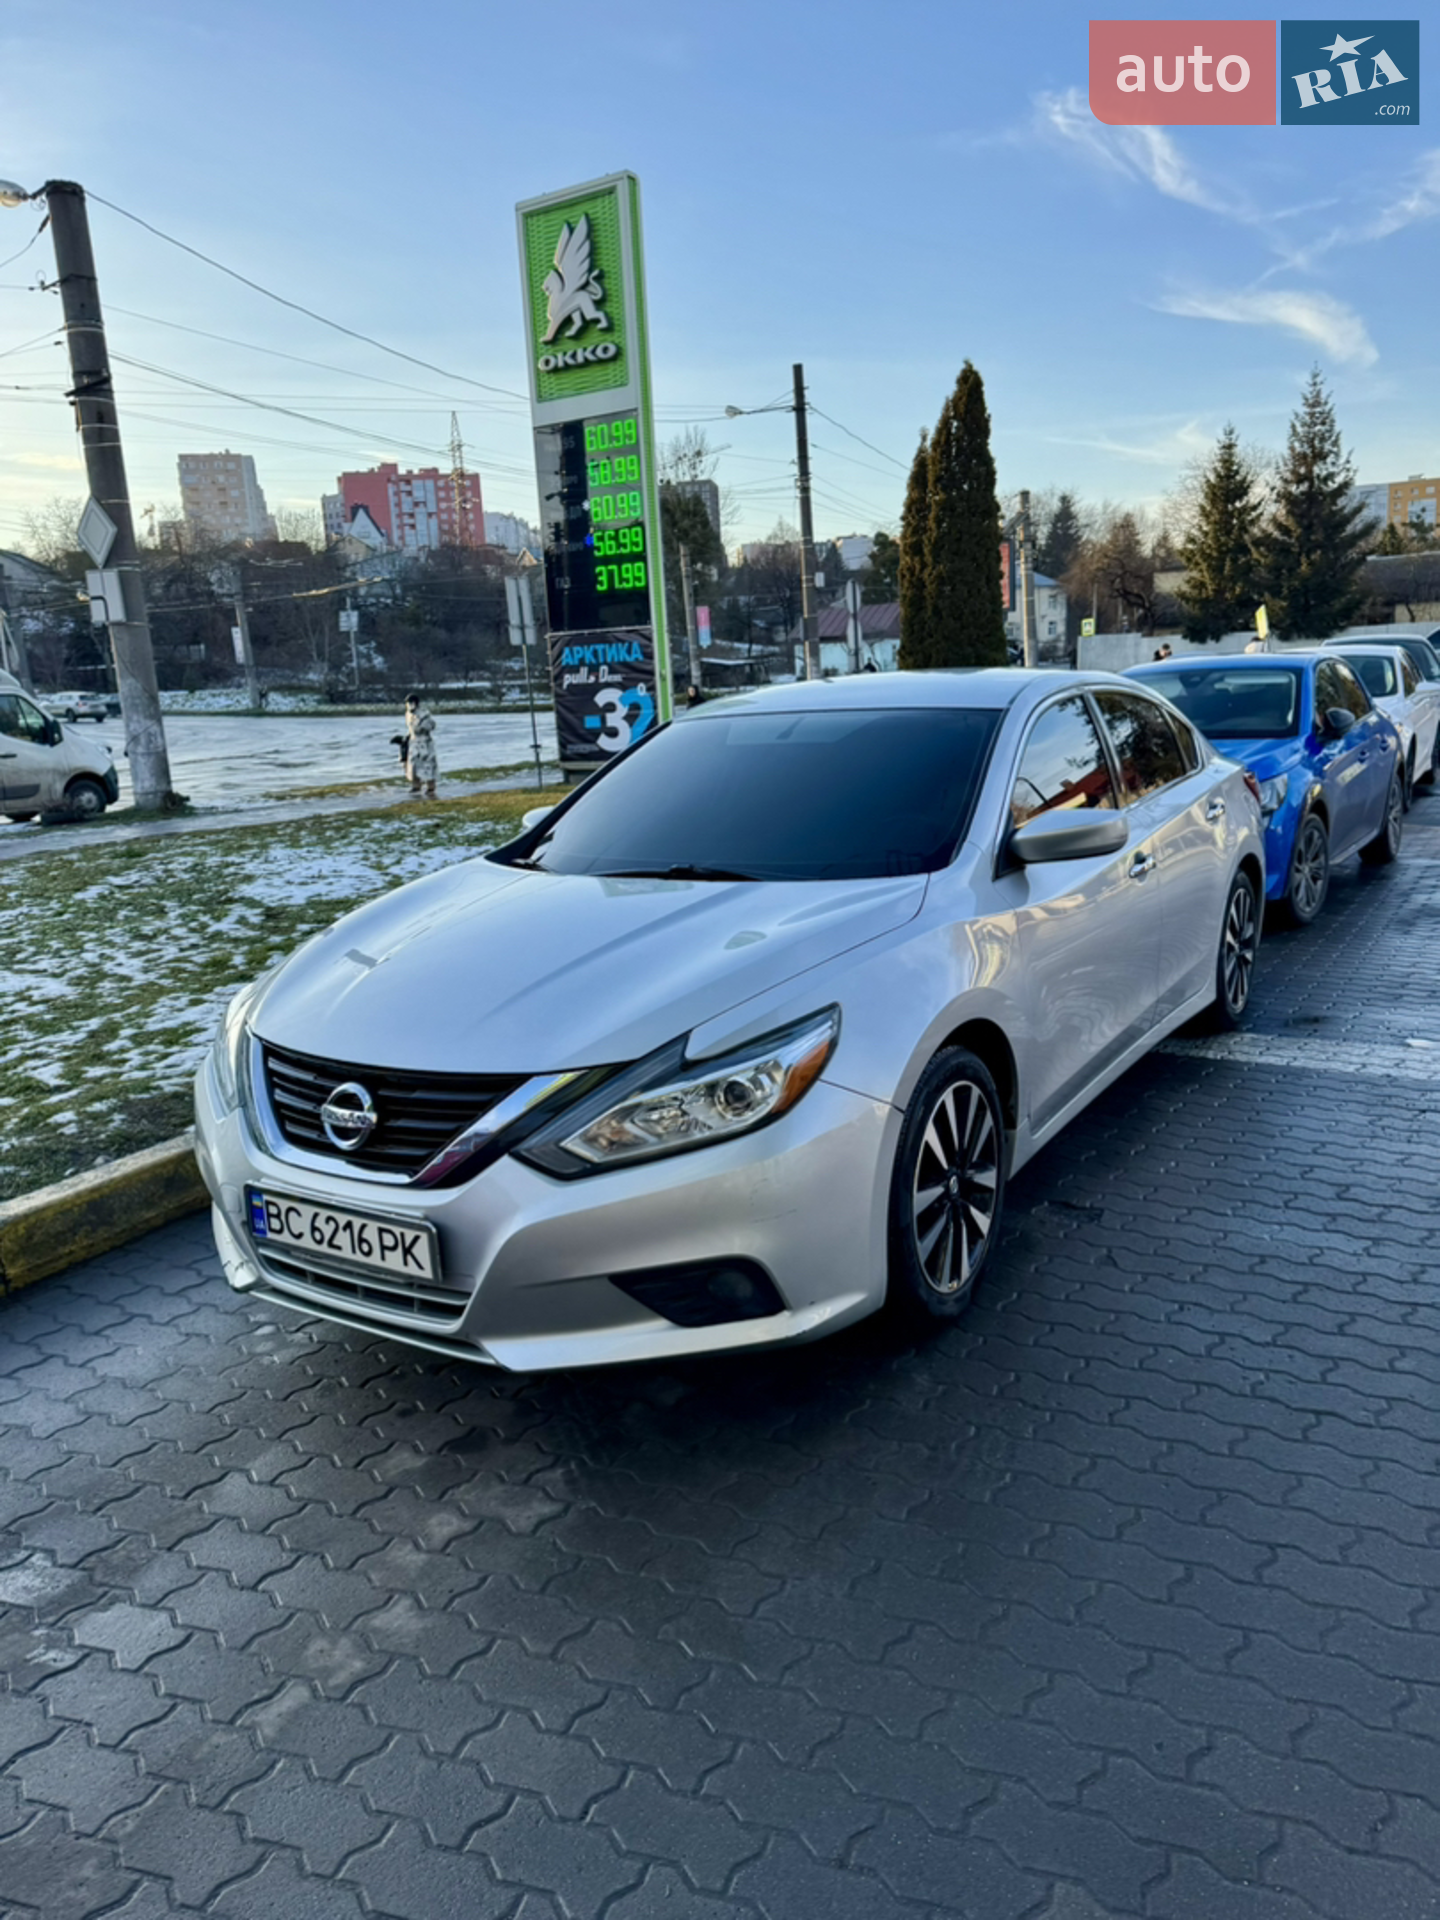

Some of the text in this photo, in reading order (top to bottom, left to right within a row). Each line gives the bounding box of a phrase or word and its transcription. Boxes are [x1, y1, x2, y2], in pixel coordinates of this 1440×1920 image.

[538, 342, 618, 372] OKKO
[585, 418, 637, 452] 60.99
[588, 454, 640, 487] 58.99
[590, 491, 641, 523] 60.99
[593, 526, 644, 557] 56.99
[595, 561, 647, 591] 37.99
[563, 642, 644, 666] АРКТИКА
